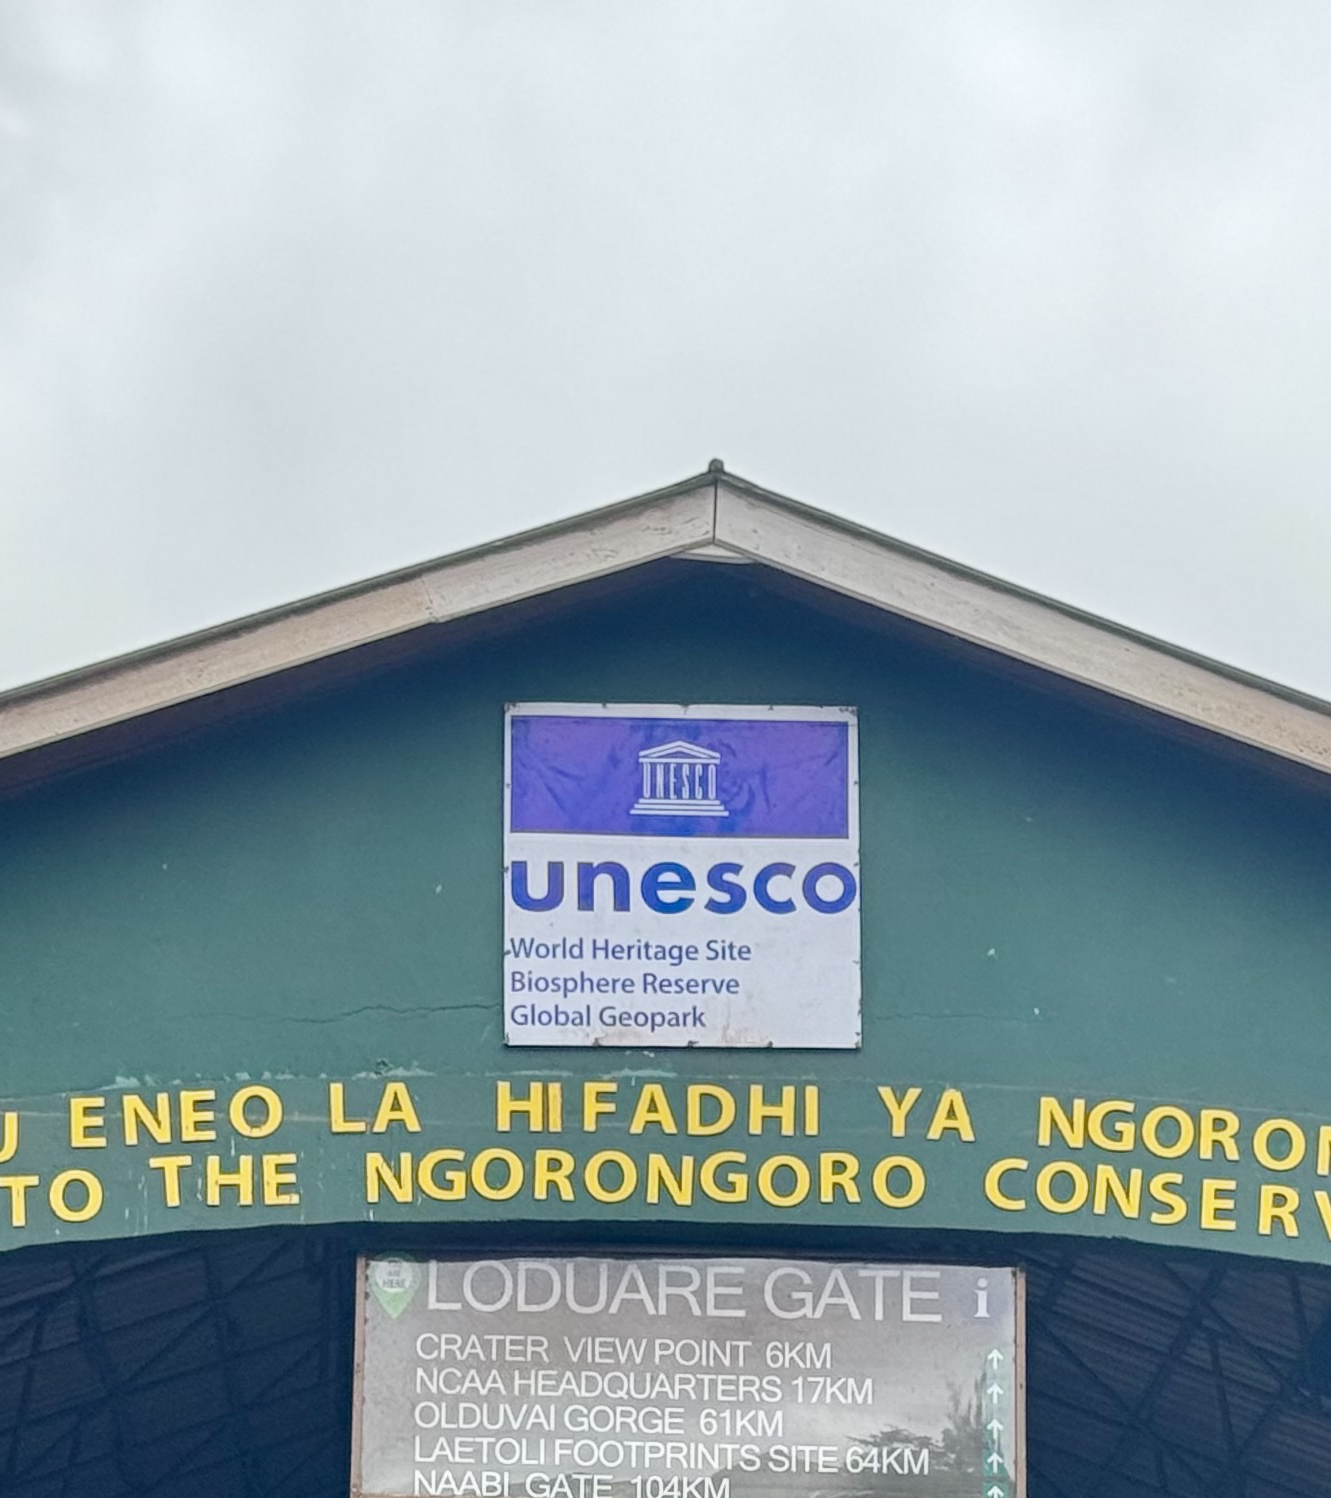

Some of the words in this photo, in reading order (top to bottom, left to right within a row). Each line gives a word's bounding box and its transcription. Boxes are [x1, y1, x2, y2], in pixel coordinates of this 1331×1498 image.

[643, 761, 717, 801] UNESCO
[510, 859, 858, 914] unesco
[511, 936, 584, 960] World
[592, 937, 700, 966] Heritage
[705, 938, 752, 961] Site
[511, 970, 636, 999] Biosphere
[643, 972, 740, 994] Reserve
[511, 1003, 590, 1027] Global
[598, 1005, 706, 1032] Geopark
[68, 1084, 285, 1150] ENEO
[328, 1080, 422, 1134] LA
[495, 1079, 820, 1137] HIFADHI
[876, 1085, 977, 1144] YA
[148, 1152, 302, 1209] THE
[365, 1146, 927, 1208] NGORONGORO
[425, 1258, 747, 1319] LODUARE
[762, 1264, 943, 1324] GATE
[415, 1333, 548, 1362] CRATER
[563, 1336, 646, 1365] VIEW
[654, 1338, 752, 1367] POINT
[764, 1341, 833, 1369] 6KM
[414, 1367, 506, 1397] NCAA
[513, 1370, 782, 1404] HEADQUARTERS
[791, 1376, 874, 1405] 17KM
[413, 1401, 556, 1432] OLDUVAI
[562, 1404, 685, 1434] GORGE
[699, 1408, 784, 1437] 61KM
[413, 1435, 547, 1467] LAETOLI
[553, 1439, 762, 1472] FOOTPRINTS
[767, 1444, 838, 1473] SITE
[845, 1446, 930, 1476] 64KM
[412, 1470, 511, 1498] NAABI
